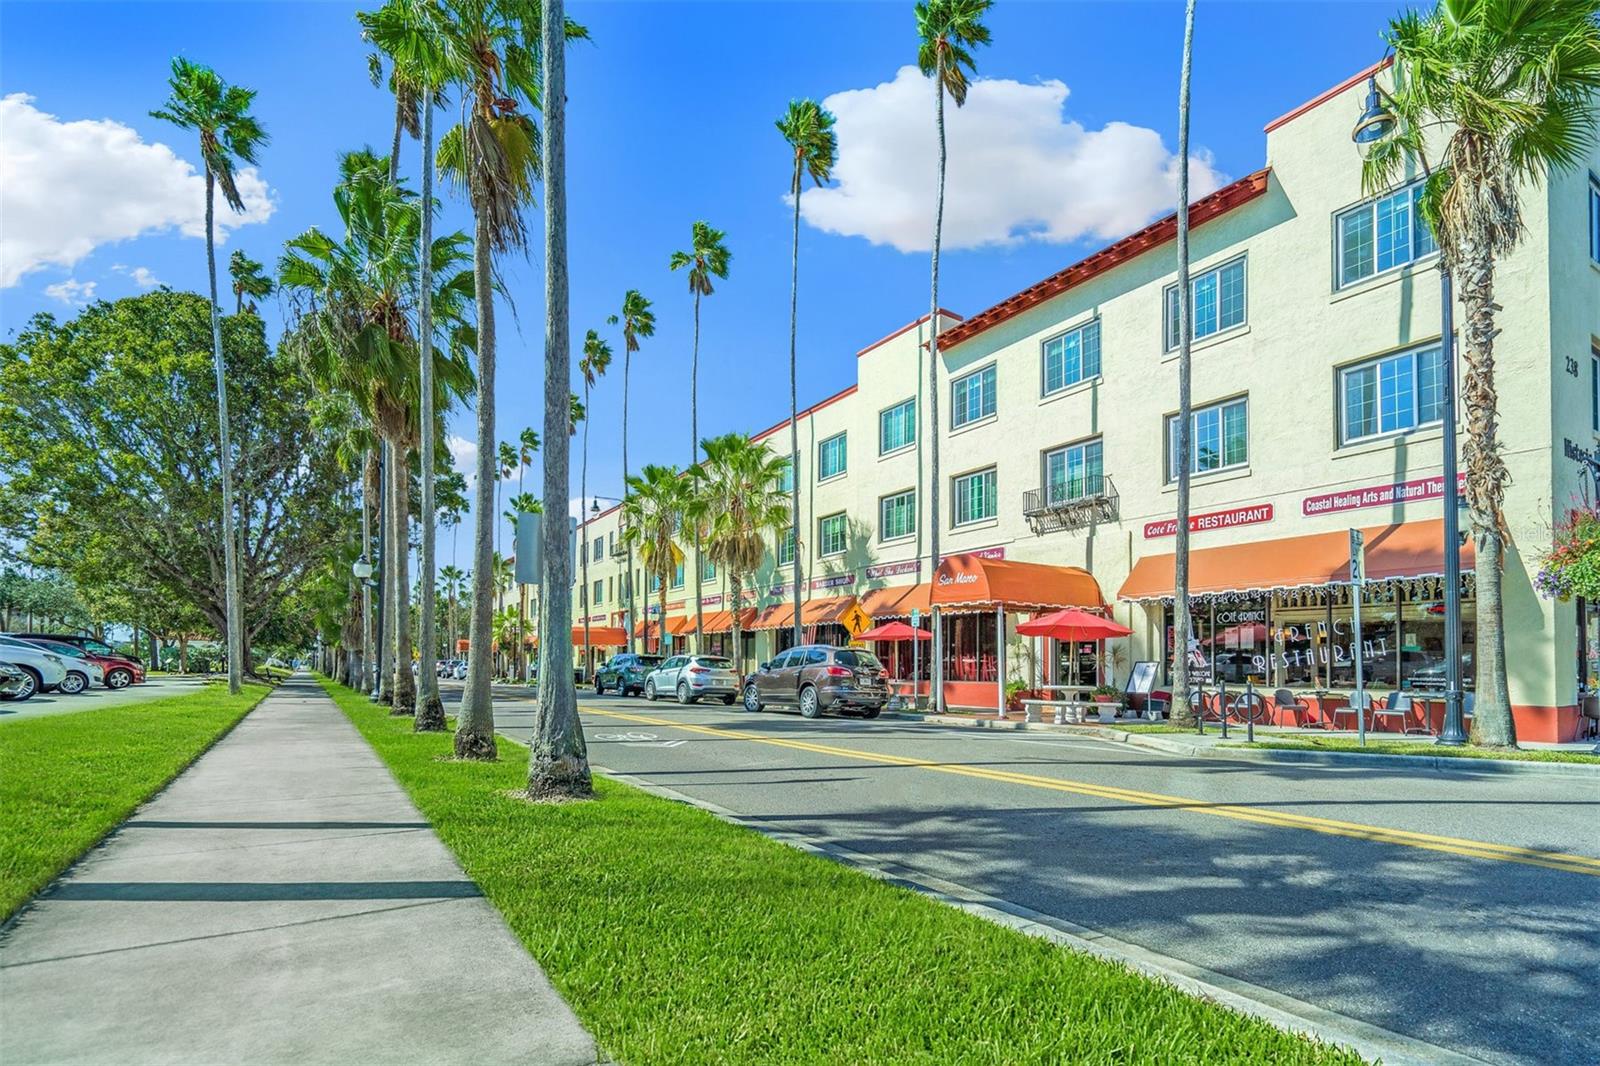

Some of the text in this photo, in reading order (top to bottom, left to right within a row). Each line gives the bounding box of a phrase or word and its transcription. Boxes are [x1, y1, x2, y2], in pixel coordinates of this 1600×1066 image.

[1306, 497, 1332, 512] Coastal
[1333, 494, 1361, 508] Healing
[1362, 491, 1378, 504] Arts
[1379, 488, 1394, 501] and
[1395, 484, 1425, 499] Natural
[1198, 507, 1270, 529] RESTAURANT
[938, 571, 978, 586] San Marco
[1252, 637, 1387, 674] RESTAURANT
